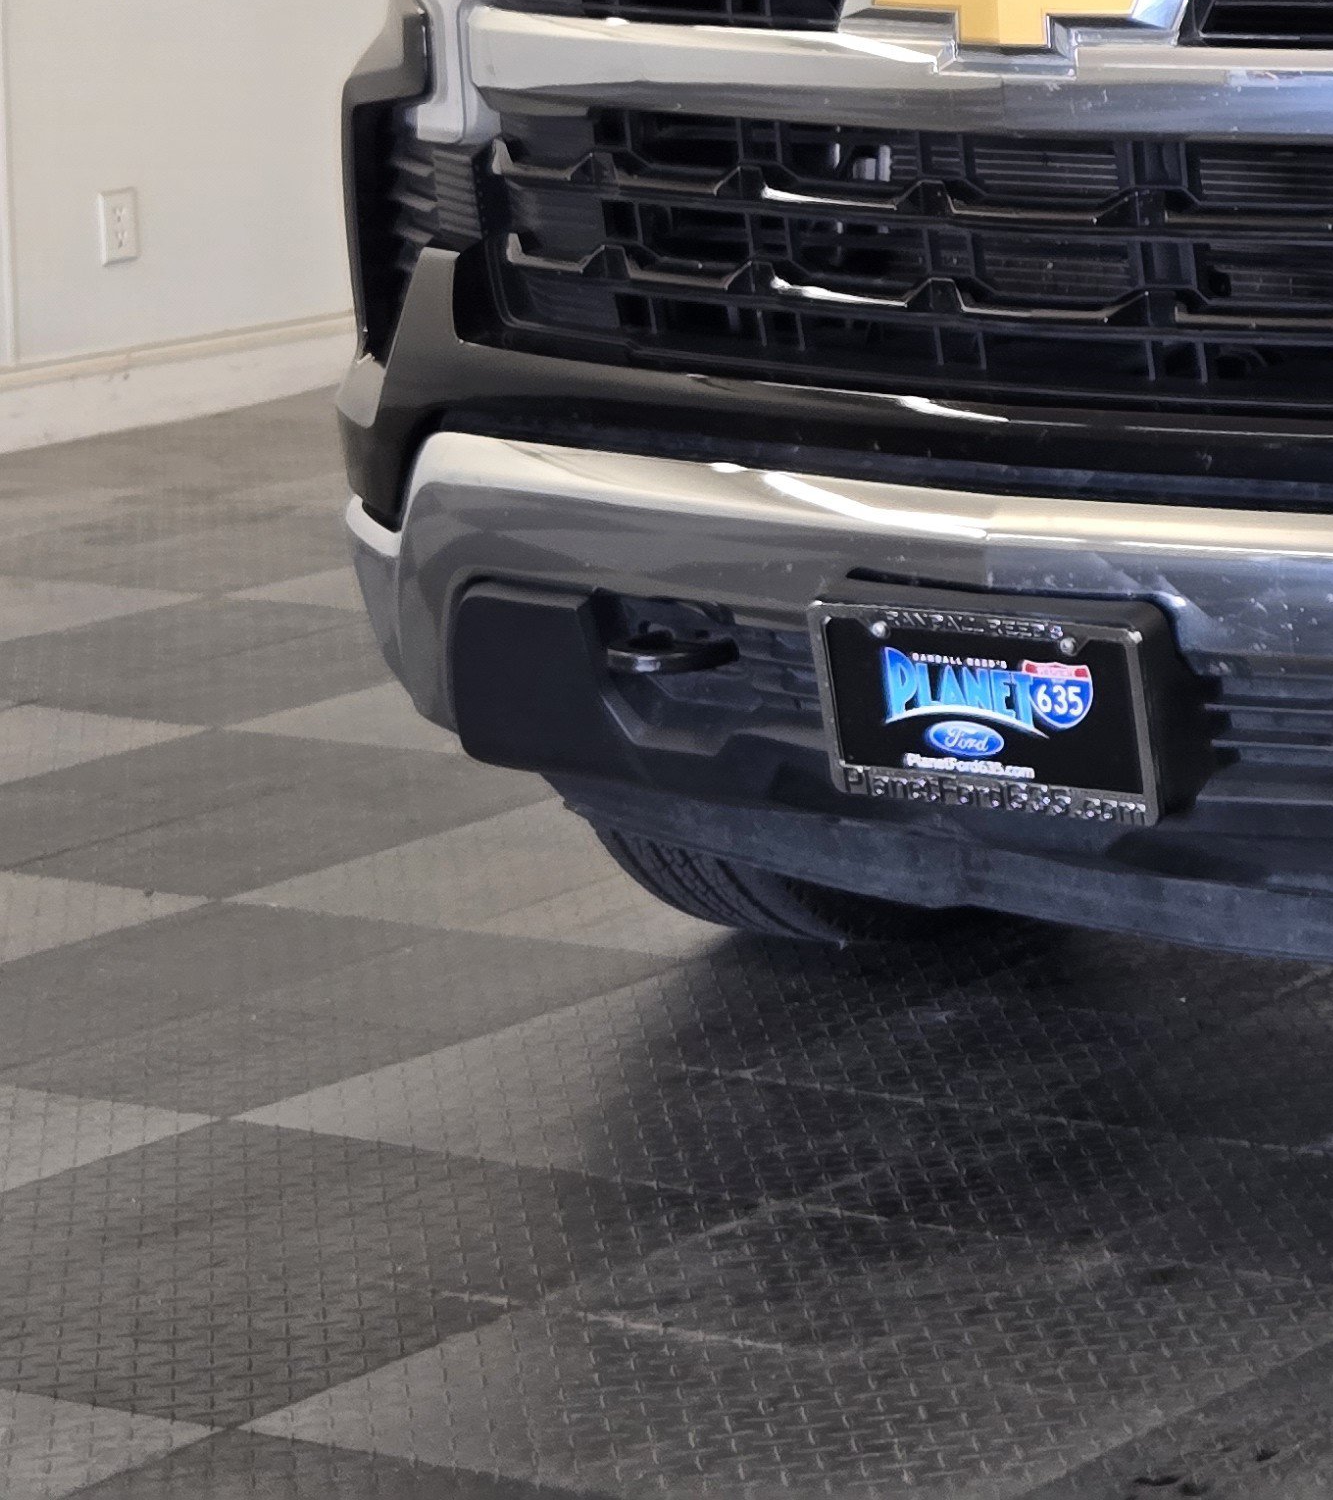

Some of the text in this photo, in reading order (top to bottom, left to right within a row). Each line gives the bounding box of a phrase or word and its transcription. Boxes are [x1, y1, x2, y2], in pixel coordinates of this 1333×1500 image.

[881, 646, 1084, 730] PLANET 635
[942, 722, 990, 754] Ford
